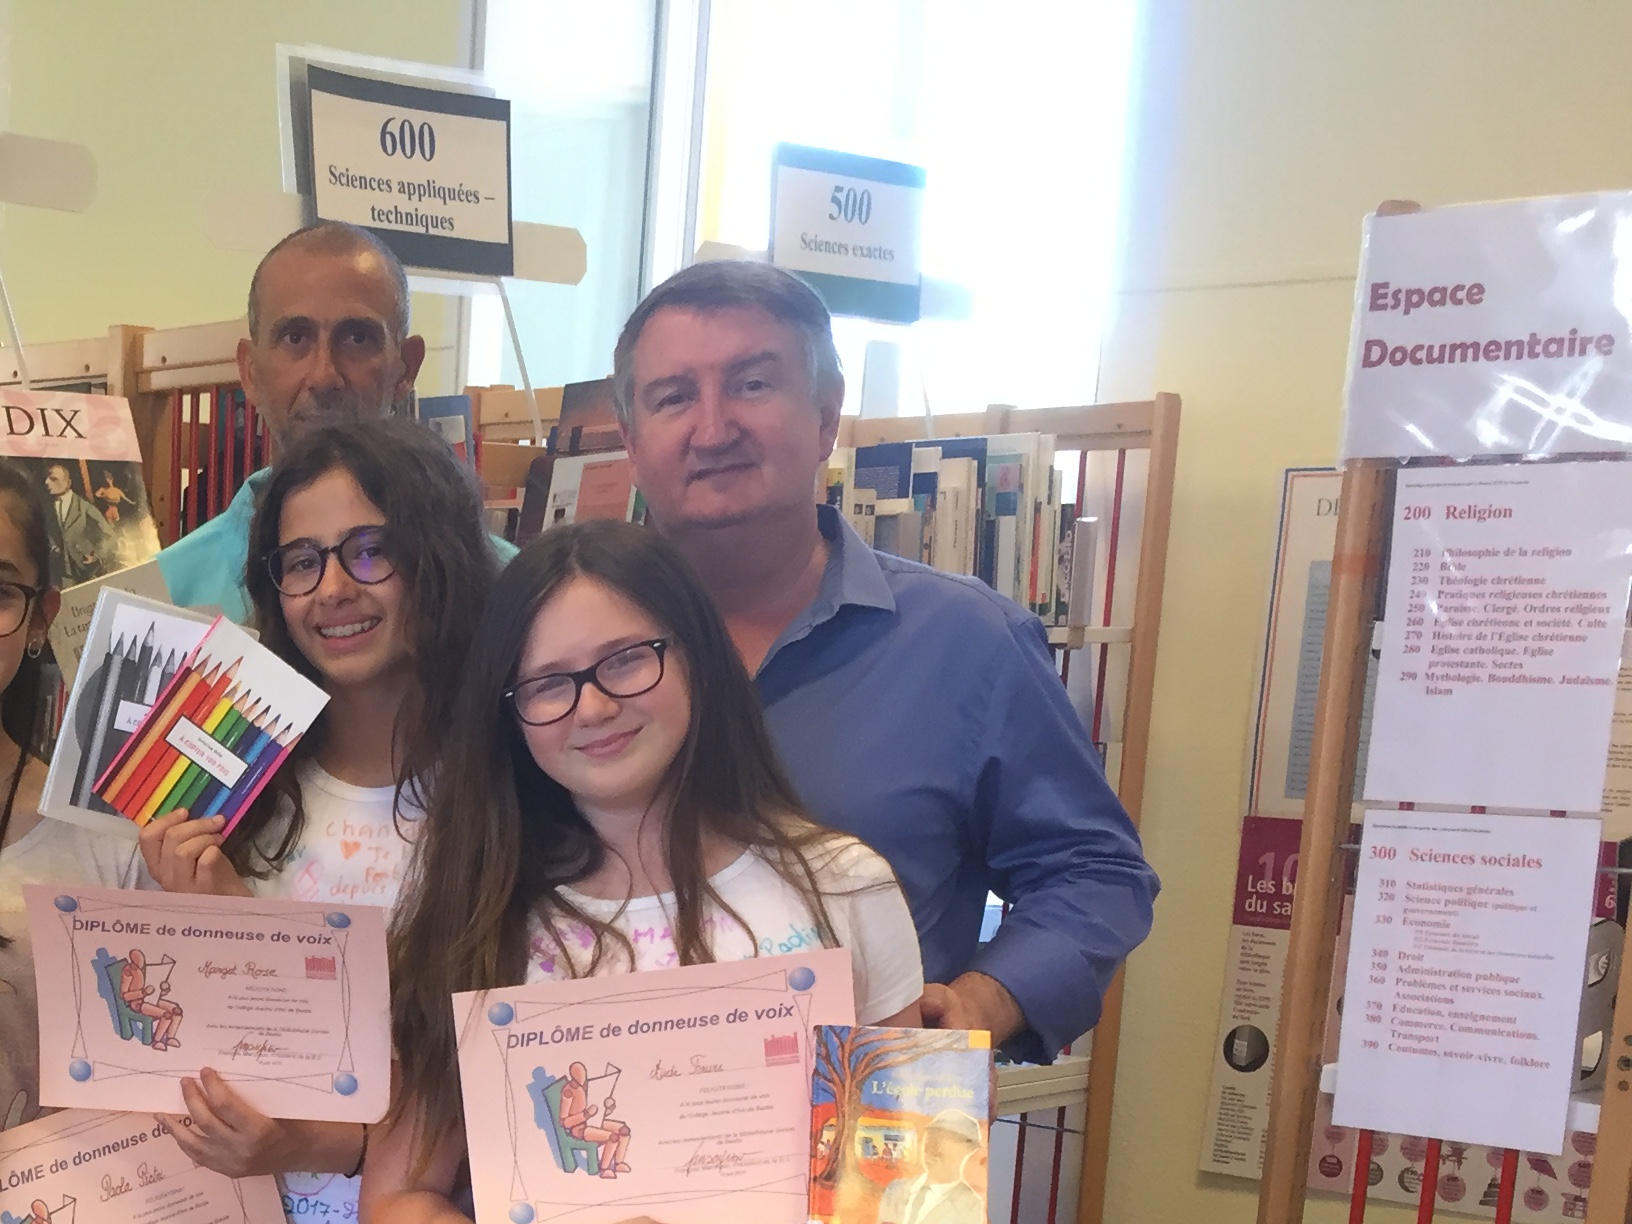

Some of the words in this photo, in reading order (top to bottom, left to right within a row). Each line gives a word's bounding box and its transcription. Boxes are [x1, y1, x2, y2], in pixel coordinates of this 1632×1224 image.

[380, 117, 435, 162] 600
[329, 165, 392, 193] Sciences
[397, 180, 480, 205] appliquées
[371, 204, 455, 233] techniques
[828, 185, 872, 225] 500
[800, 232, 849, 256] Sciences
[852, 245, 895, 262] exactes
[1368, 281, 1486, 315] Espace
[1362, 328, 1616, 369] Documentaire
[1, 405, 87, 439] DIX
[1403, 505, 1432, 521] 200
[1445, 504, 1513, 523] Religion
[1369, 845, 1397, 861] 300
[1409, 847, 1477, 866] Sciences
[1480, 852, 1544, 869] sociales
[1248, 875, 1276, 895] Les
[1244, 894, 1268, 913] du
[72, 917, 151, 937] DIPLÔME
[156, 922, 176, 938] de
[181, 924, 265, 942] donneuse
[270, 930, 291, 944] de
[296, 932, 333, 946] voix
[507, 1025, 594, 1050] DIPLÔME
[599, 1022, 623, 1039] de
[627, 1013, 720, 1036] donneuse
[726, 1009, 749, 1025] de
[755, 1003, 795, 1021] voix
[49, 1157, 69, 1175] de
[72, 1131, 148, 1167] donneuse
